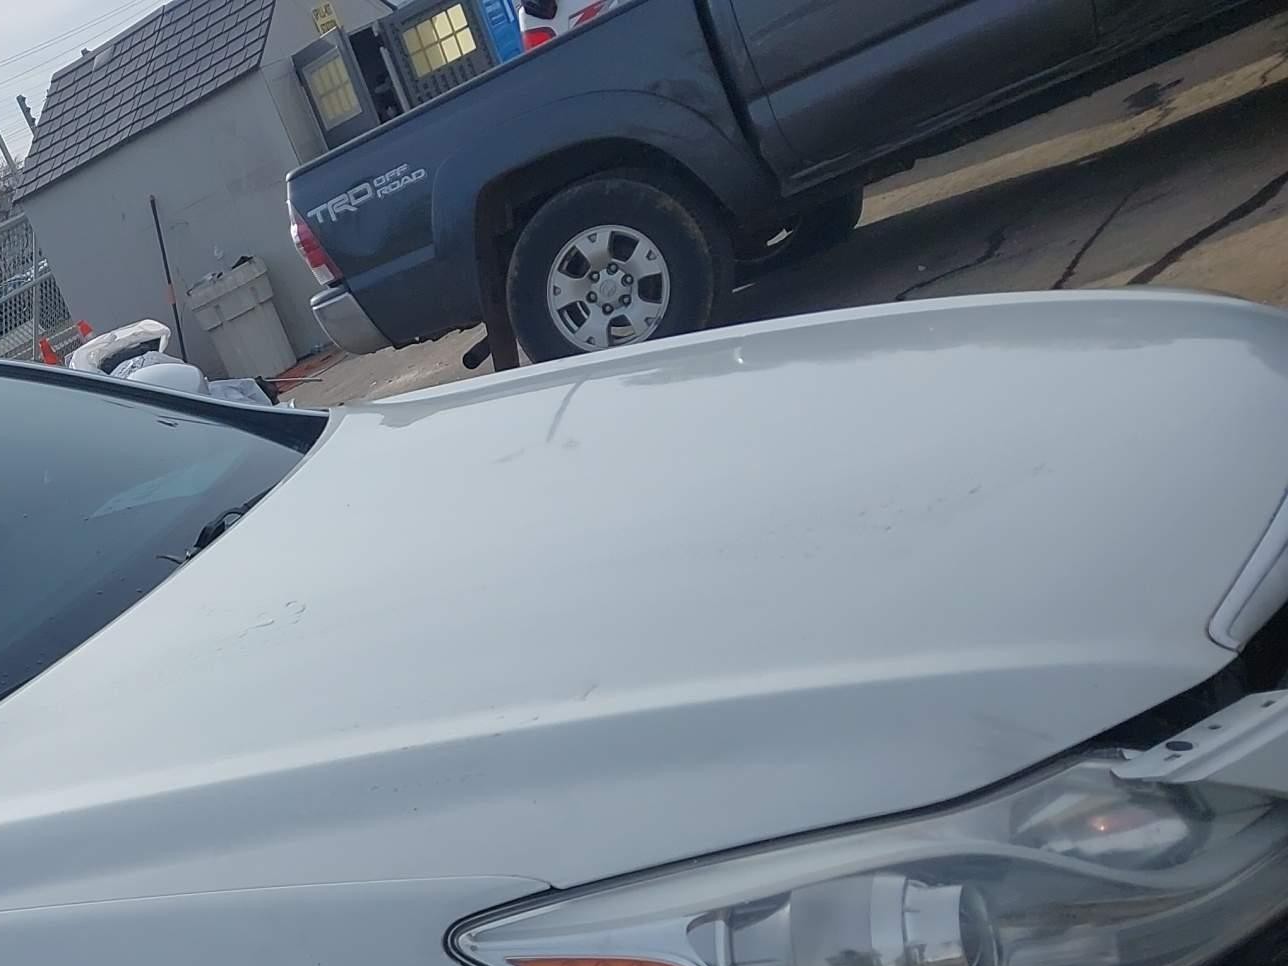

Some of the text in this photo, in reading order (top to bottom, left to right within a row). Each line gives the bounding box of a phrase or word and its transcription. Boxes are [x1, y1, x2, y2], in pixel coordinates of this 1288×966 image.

[373, 163, 410, 186] OFF
[376, 168, 427, 199] ROAD
[306, 182, 373, 224] TRD
